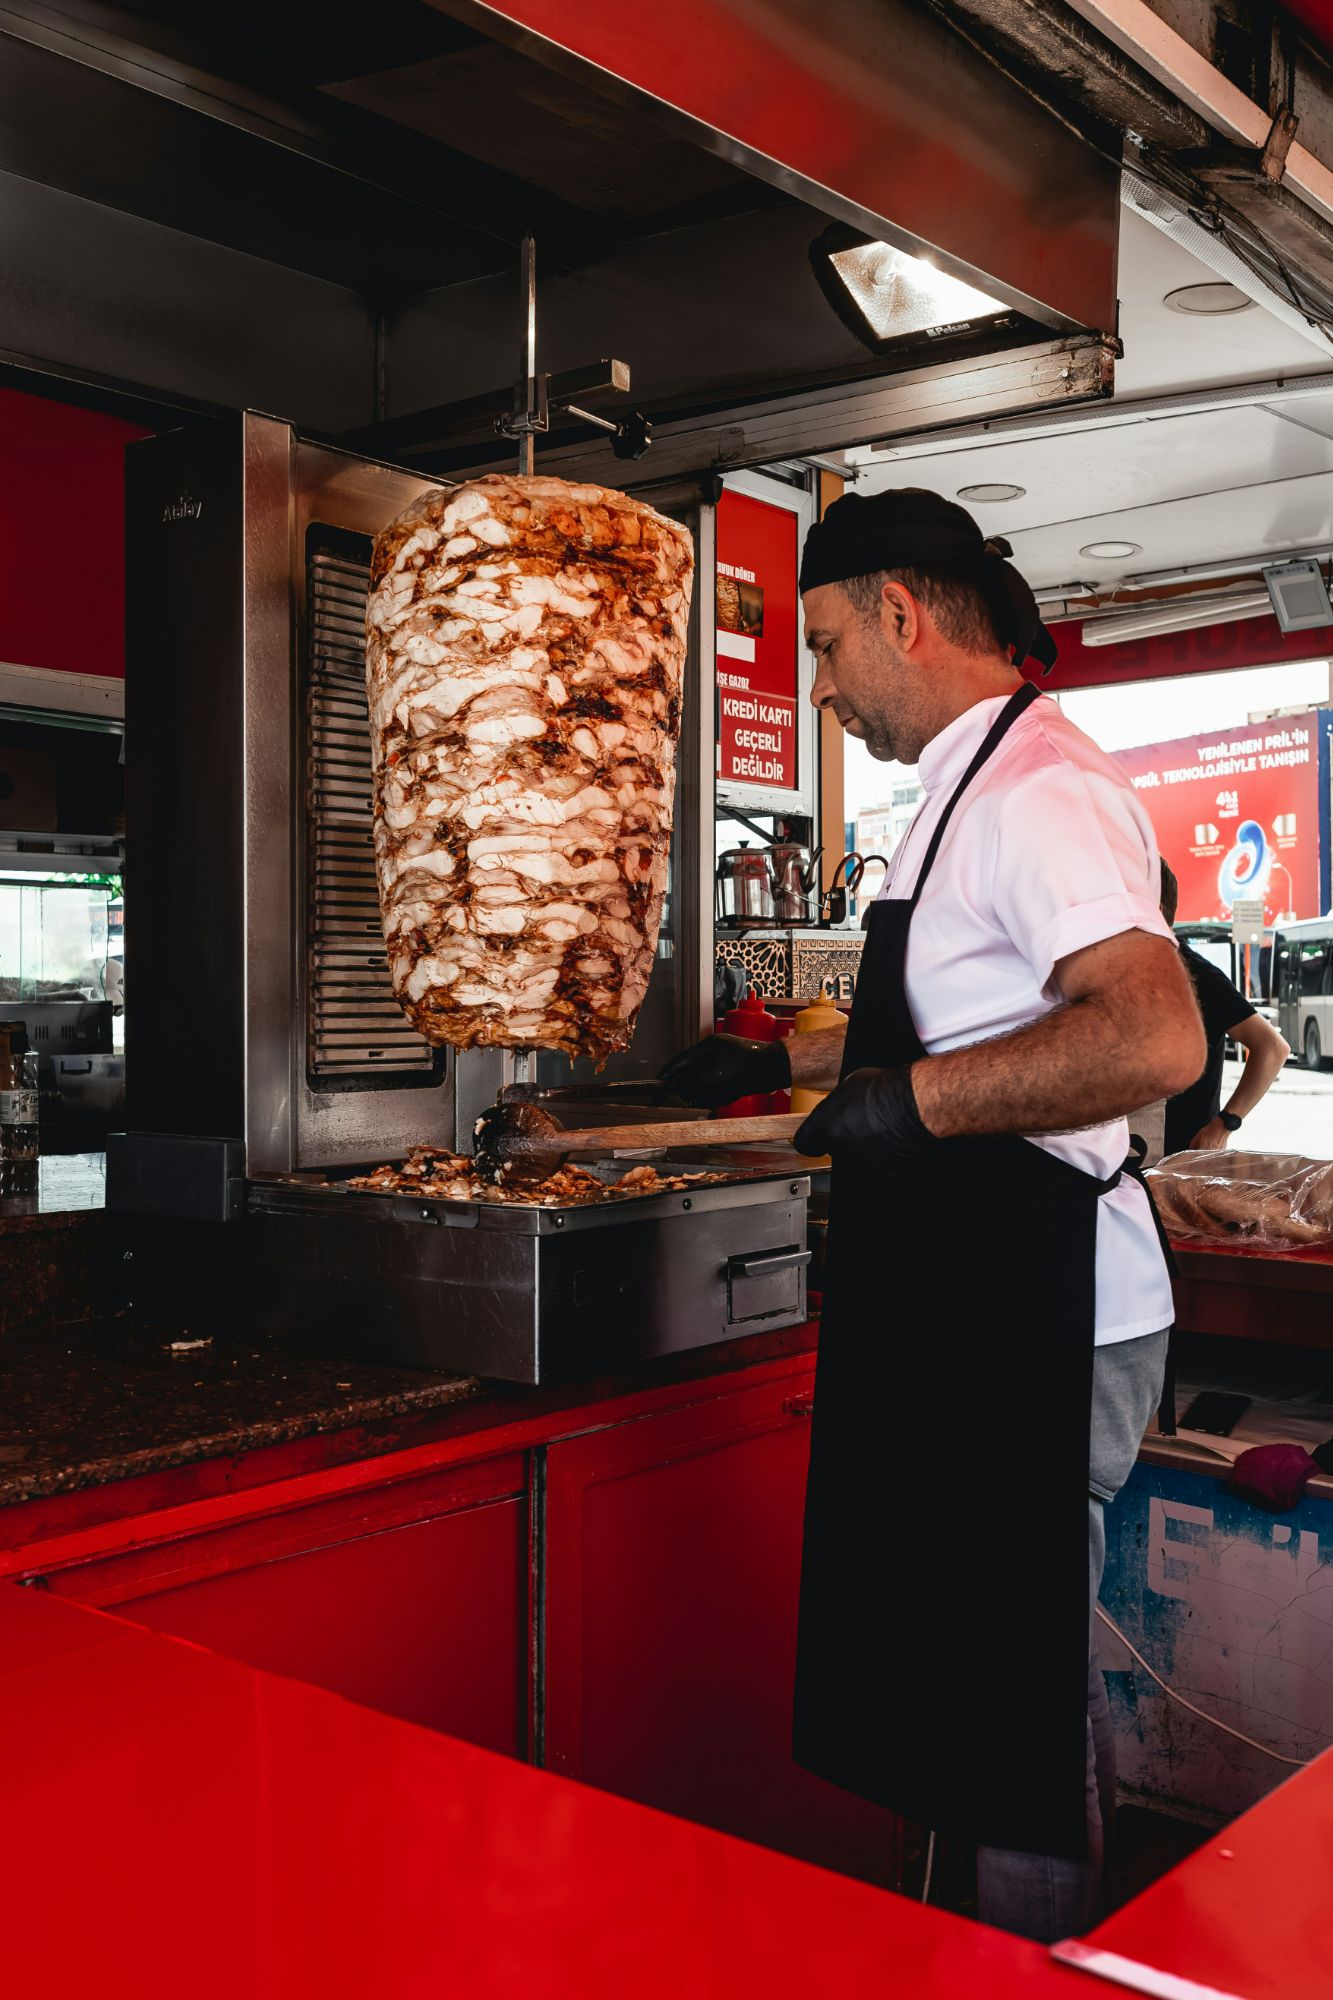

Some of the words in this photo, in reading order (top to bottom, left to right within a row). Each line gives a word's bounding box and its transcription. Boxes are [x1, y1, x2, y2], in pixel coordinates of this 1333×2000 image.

[935, 322, 971, 336] Pelsan
[717, 561, 734, 578] AVUK
[735, 567, 756, 583] DÖNER
[717, 669, 728, 687] İŞE
[729, 674, 750, 690] GAZOZ
[723, 695, 758, 721] KREDİ
[759, 705, 792, 728] KARTI
[735, 729, 781, 753] GEÇERLİ
[1197, 738, 1263, 761] YENİLENEN
[1265, 728, 1309, 751] PRİL'İN
[733, 753, 783, 781] DEĞİLDİR
[1163, 757, 1257, 785] TEKNOLOJİSİYLE
[1258, 749, 1309, 770] TANIŞIN
[822, 975, 857, 1000] CE
